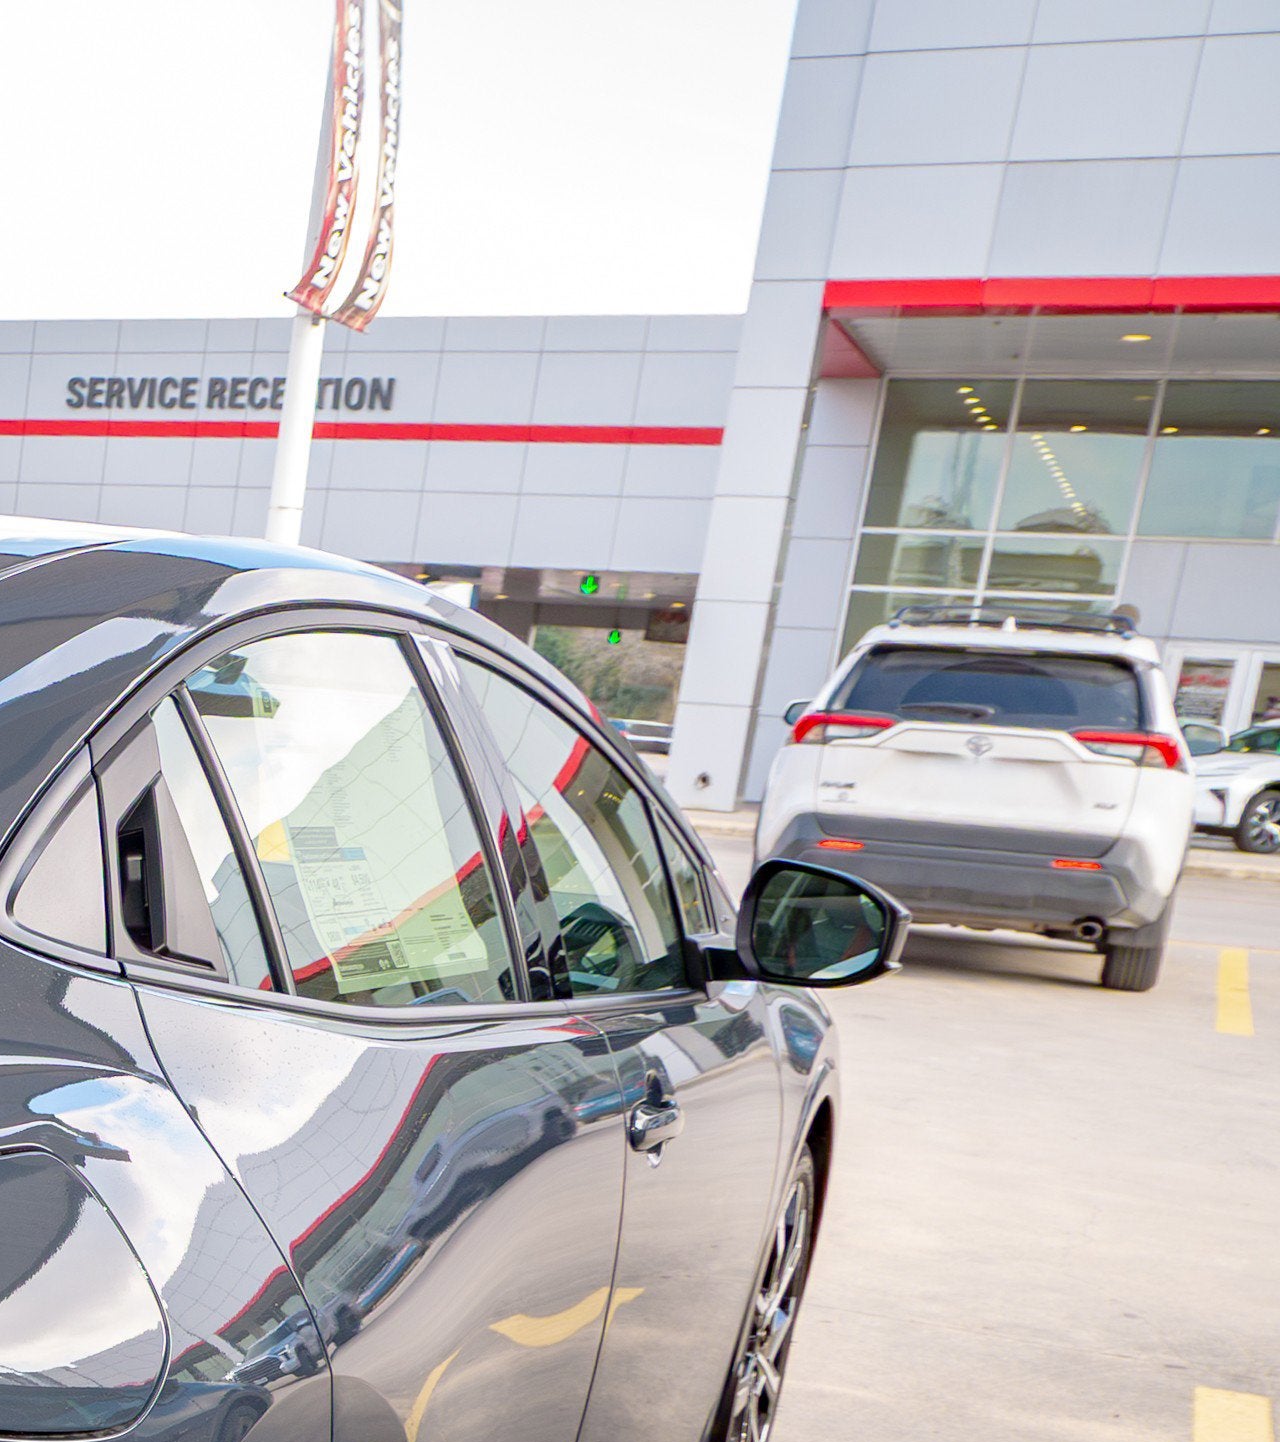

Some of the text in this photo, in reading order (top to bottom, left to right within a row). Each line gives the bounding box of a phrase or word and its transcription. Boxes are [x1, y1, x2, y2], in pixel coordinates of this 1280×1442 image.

[311, 2, 361, 289] New Vehicles
[354, 37, 400, 311] New Vehicles
[65, 376, 396, 411] SERVICE RECETION
